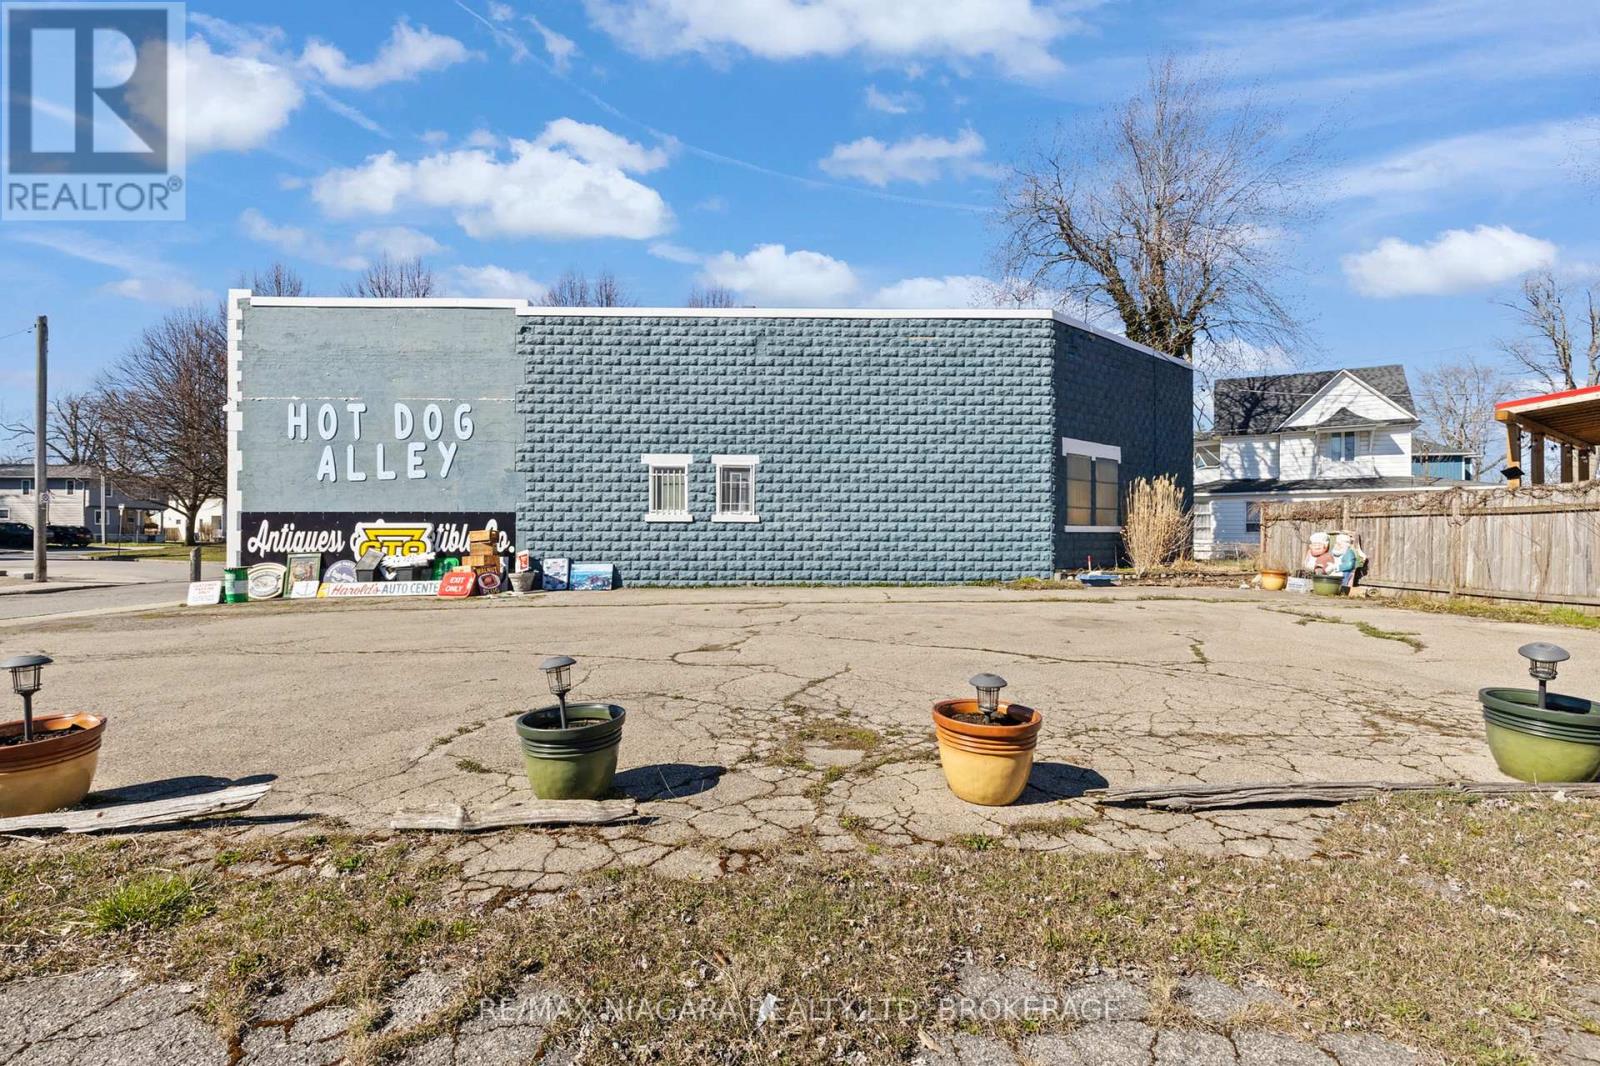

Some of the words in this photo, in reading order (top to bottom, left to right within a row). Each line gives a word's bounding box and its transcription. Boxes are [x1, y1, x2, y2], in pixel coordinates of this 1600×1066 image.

[287, 402, 367, 441] HOT
[394, 402, 475, 441] DOG
[316, 441, 458, 483] ALLEY
[331, 582, 379, 596] Harold's
[381, 583, 409, 595] AUTO
[409, 582, 438, 594] CENTE
[449, 576, 465, 584] EXIT
